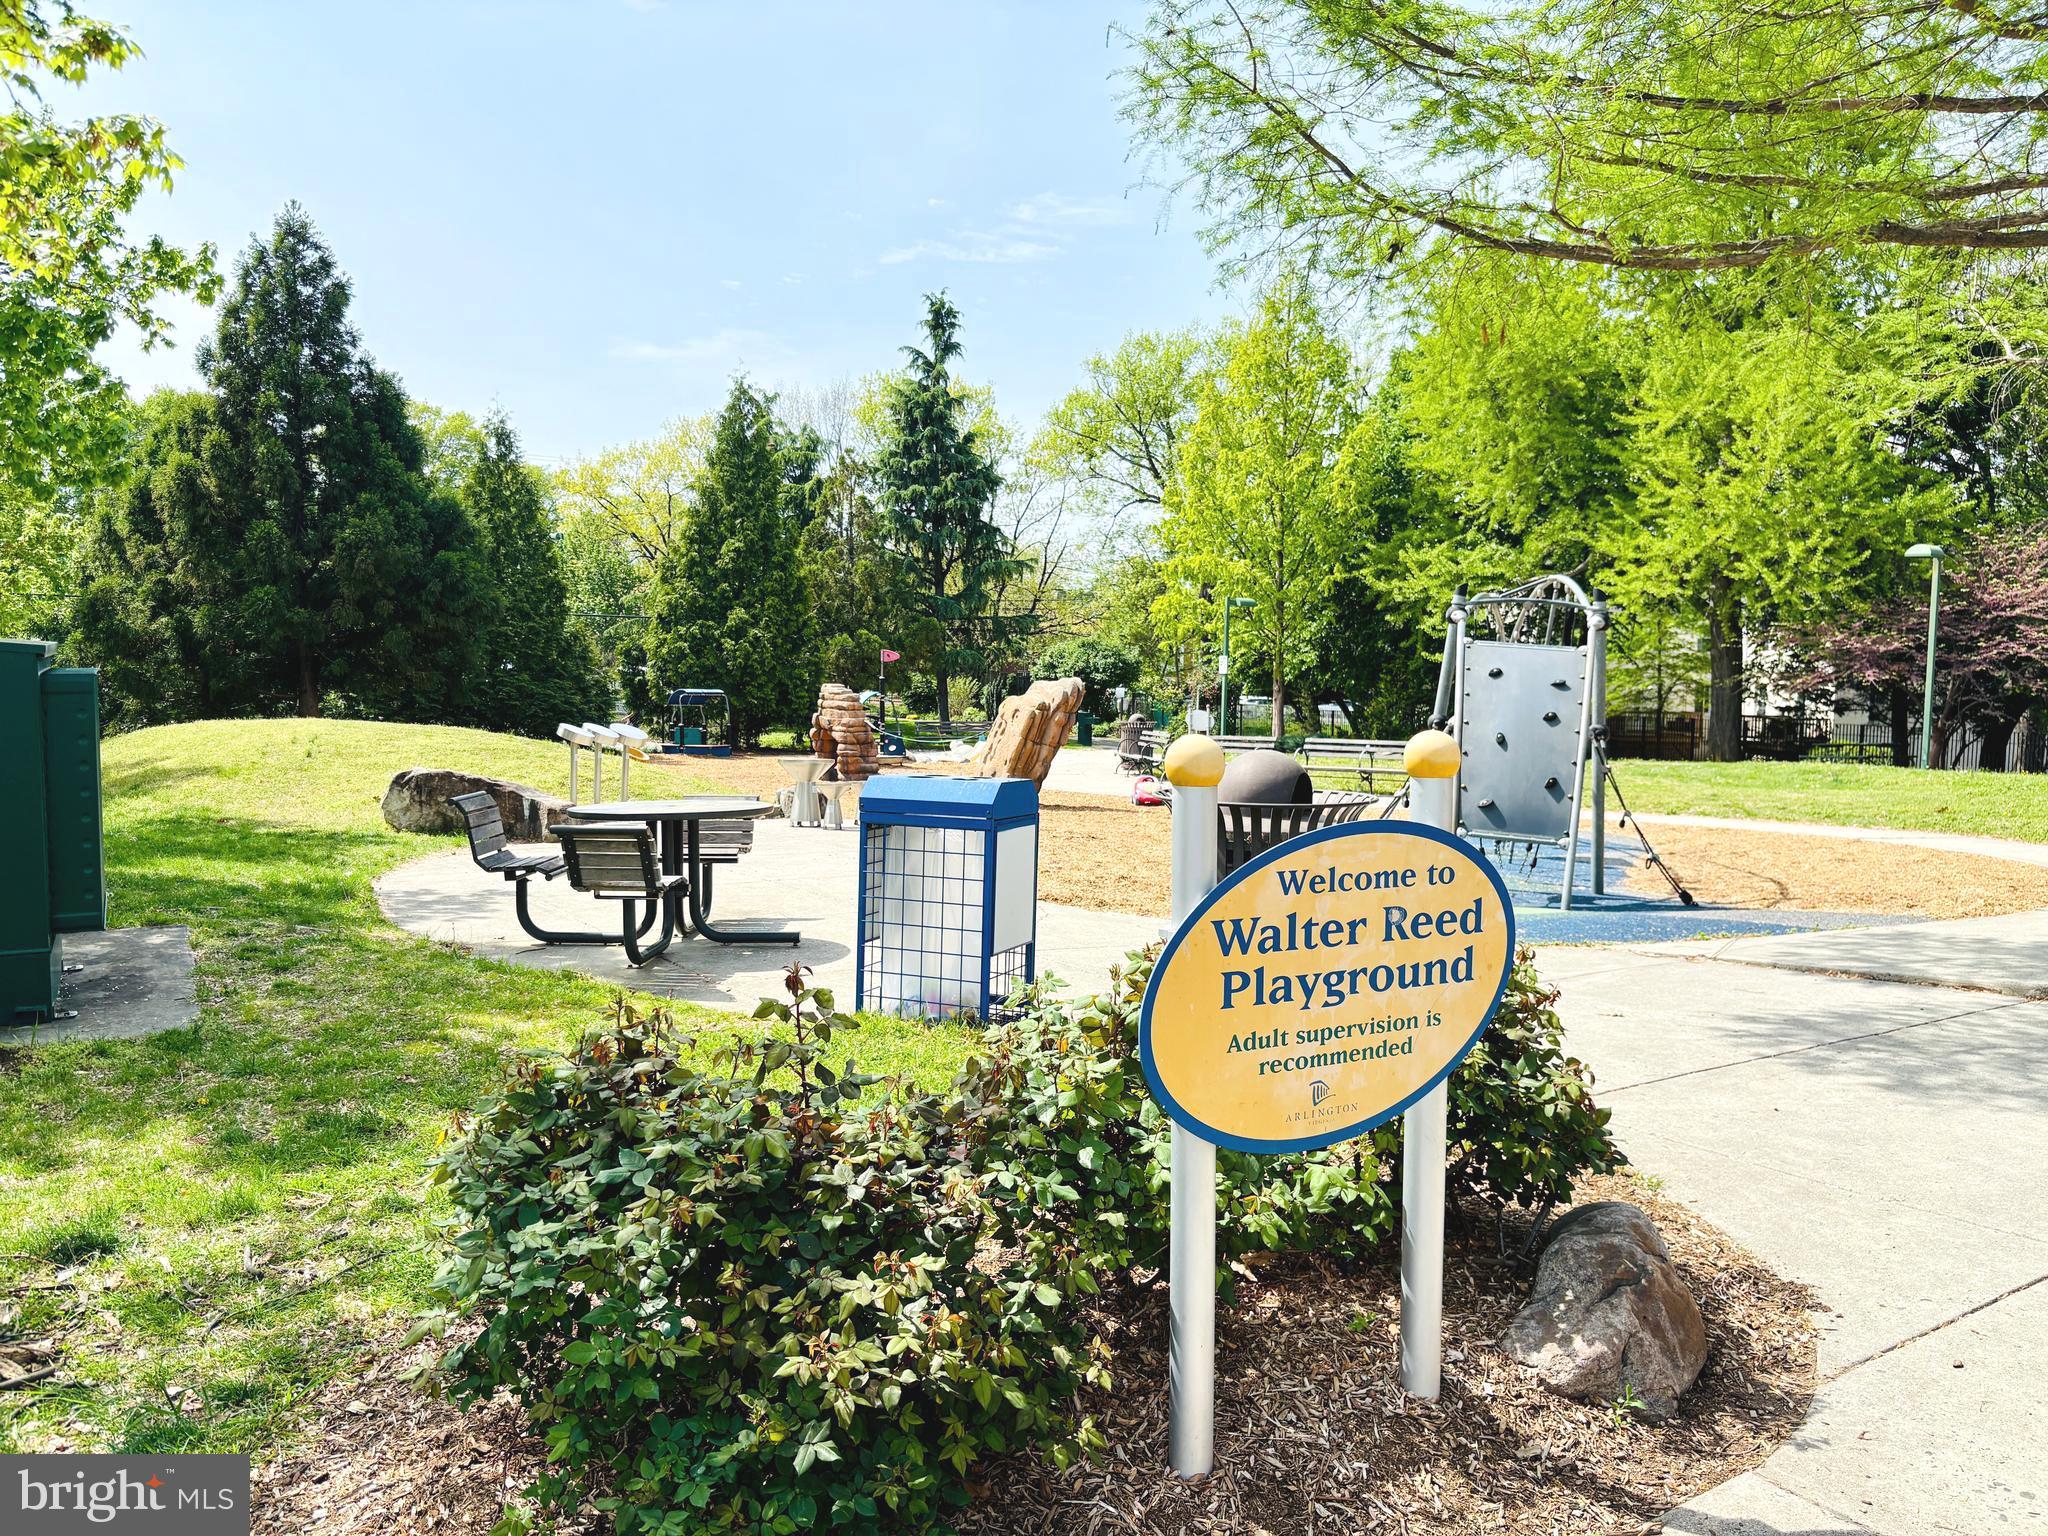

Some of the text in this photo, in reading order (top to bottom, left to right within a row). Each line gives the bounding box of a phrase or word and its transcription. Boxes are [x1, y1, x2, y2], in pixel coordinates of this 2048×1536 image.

[1276, 864, 1456, 896] Welcome to
[1210, 897, 1484, 957] Walter Reed
[1220, 945, 1475, 1010] Playground
[1226, 1010, 1442, 1053] Adult supervision is
[1258, 1036, 1414, 1075] recommended
[1285, 1102, 1359, 1123] ARLINGTON
